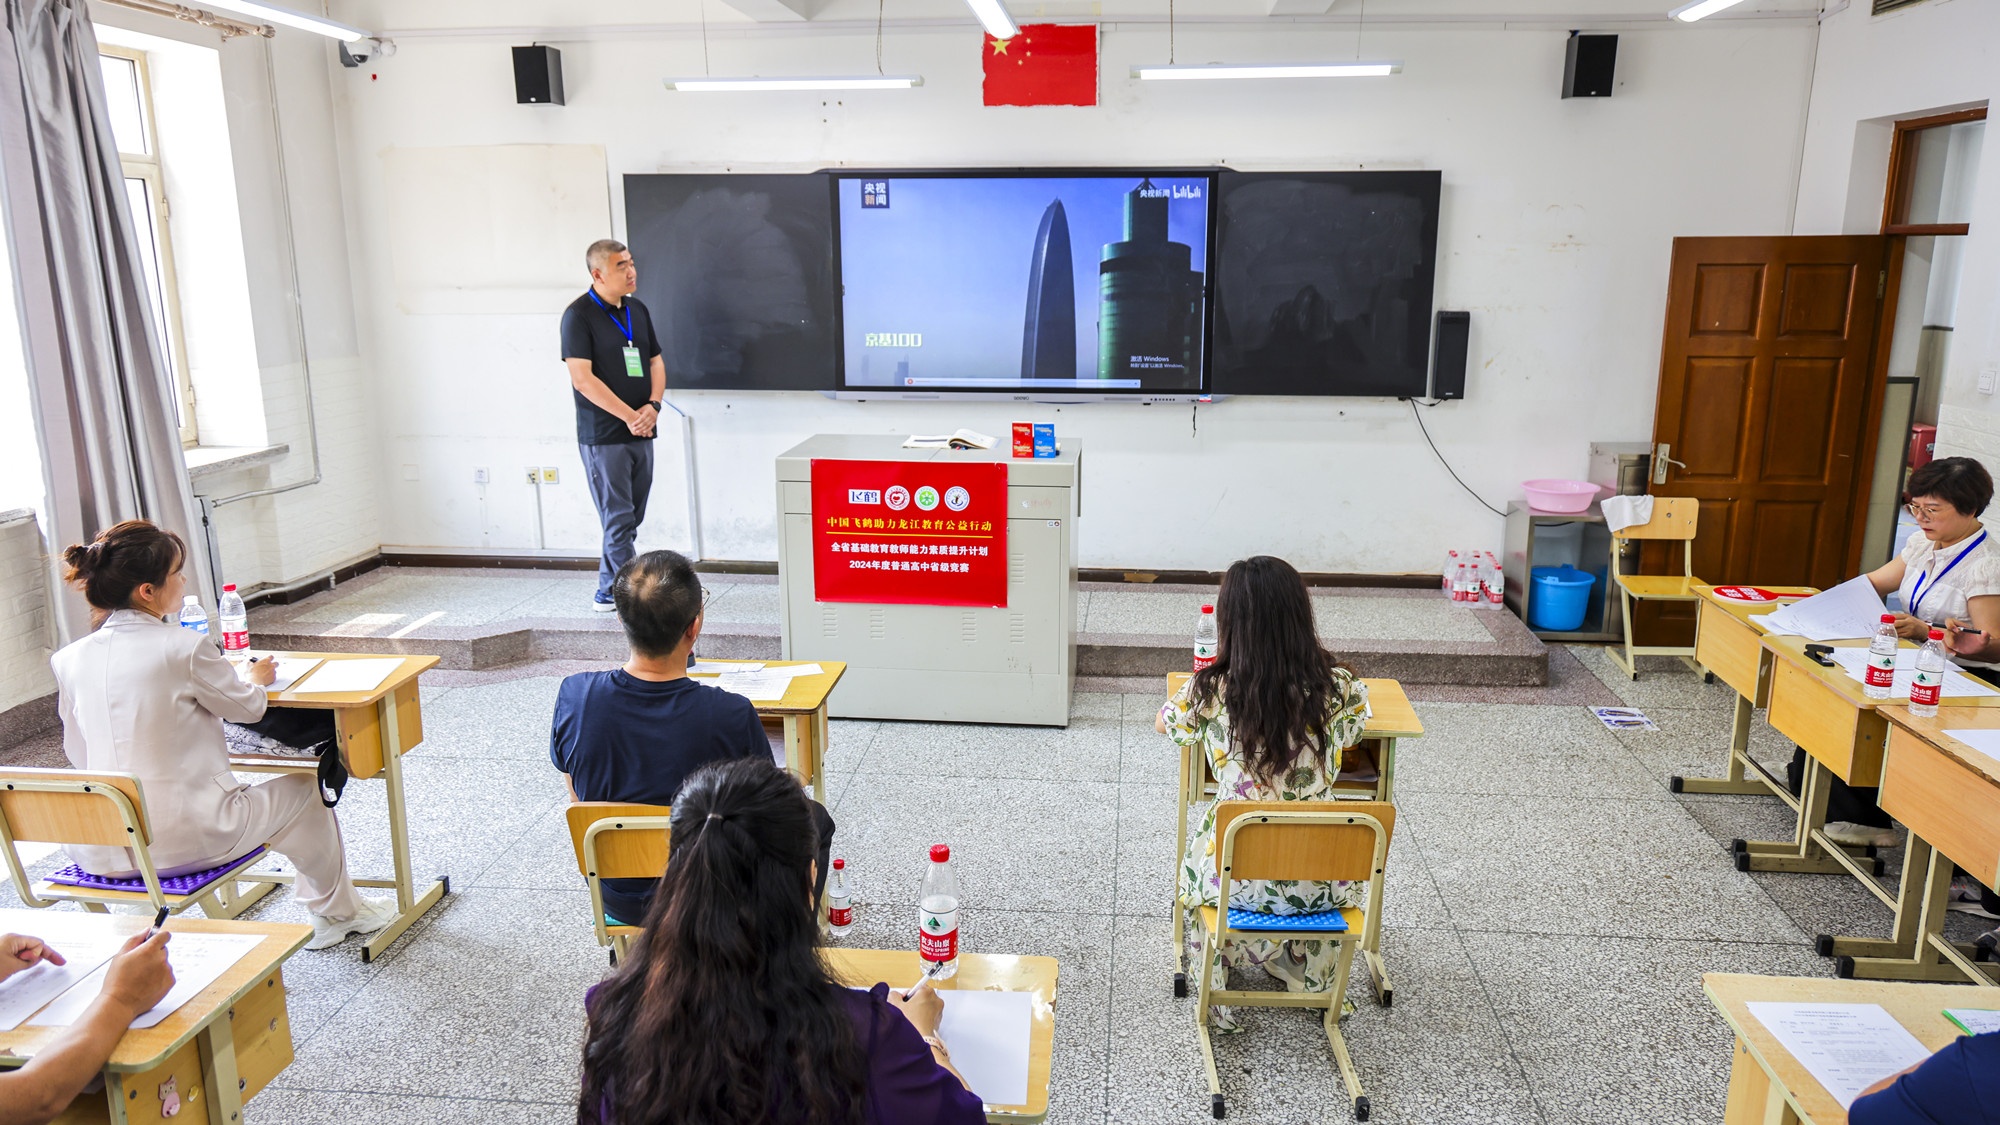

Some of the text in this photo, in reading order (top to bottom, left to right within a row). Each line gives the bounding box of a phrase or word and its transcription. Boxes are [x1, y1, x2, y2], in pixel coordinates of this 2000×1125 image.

[865, 183, 886, 194] 央视
[1140, 189, 1170, 198] 央视新闻
[1173, 185, 1201, 199] bilibili
[865, 194, 886, 206] 新闻
[865, 333, 922, 347] 京基100
[827, 516, 992, 532] 中国飞鹤助力龙江教育公益行动
[831, 541, 989, 557] 全省基础教育教师能力素质提升计划
[849, 560, 970, 573] 2024年度普通高中省级竞赛
